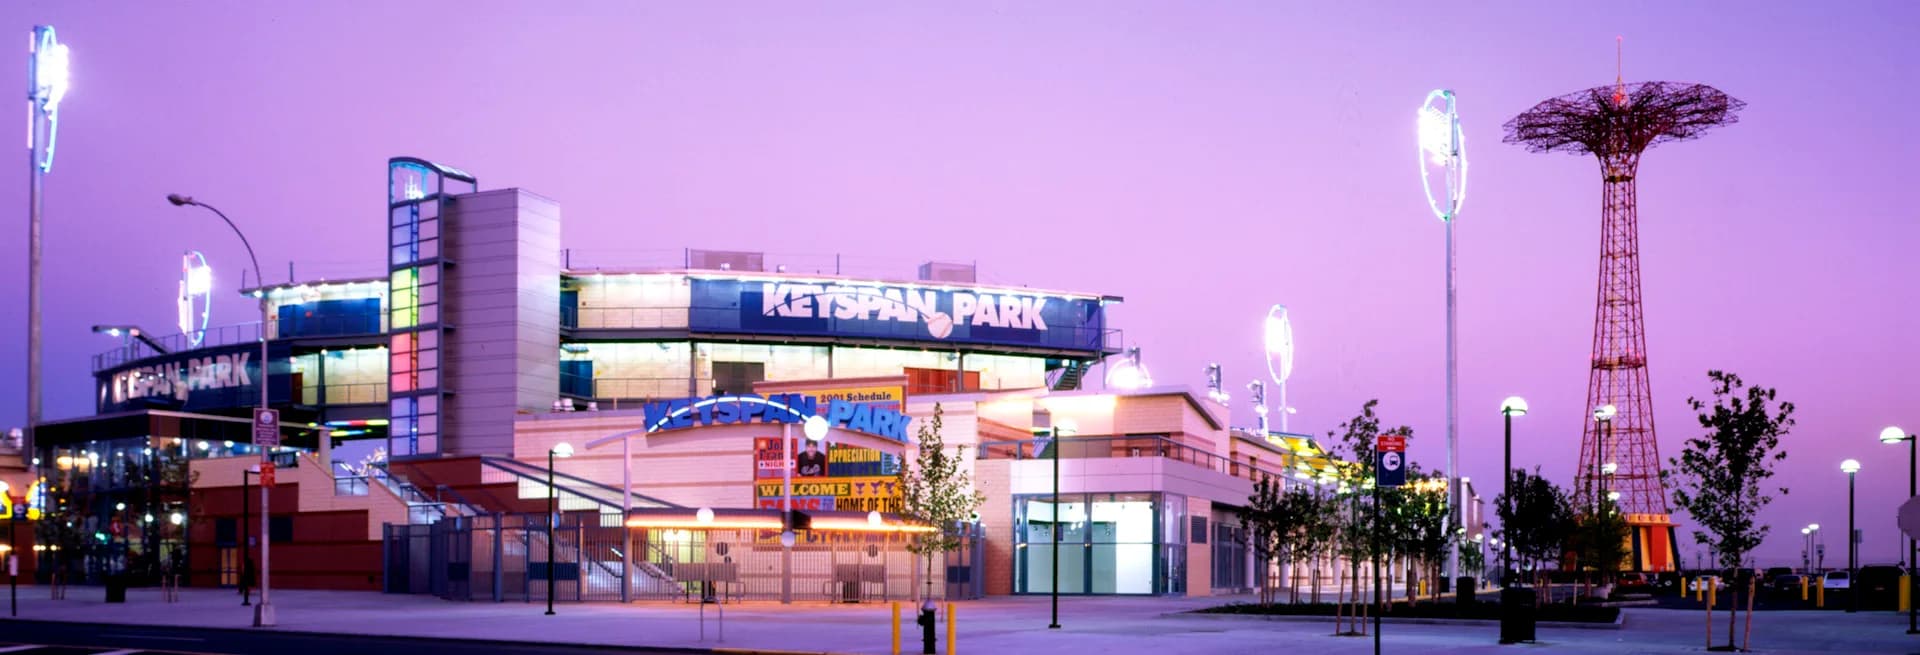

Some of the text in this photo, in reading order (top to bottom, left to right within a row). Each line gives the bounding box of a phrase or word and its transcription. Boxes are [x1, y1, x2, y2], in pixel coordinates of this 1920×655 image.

[763, 283, 1047, 330] KEYSPAN PARK
[188, 352, 251, 390] PARK
[821, 392, 892, 402] 2001 Schedule
[643, 393, 912, 443] KEYSPAN PARK
[760, 449, 795, 460] Fran
[829, 448, 881, 463] APPRECIATION
[760, 483, 849, 496] WELCOME
[836, 498, 864, 512] HOME
[867, 498, 880, 512] OF
[882, 498, 903, 512] THE
